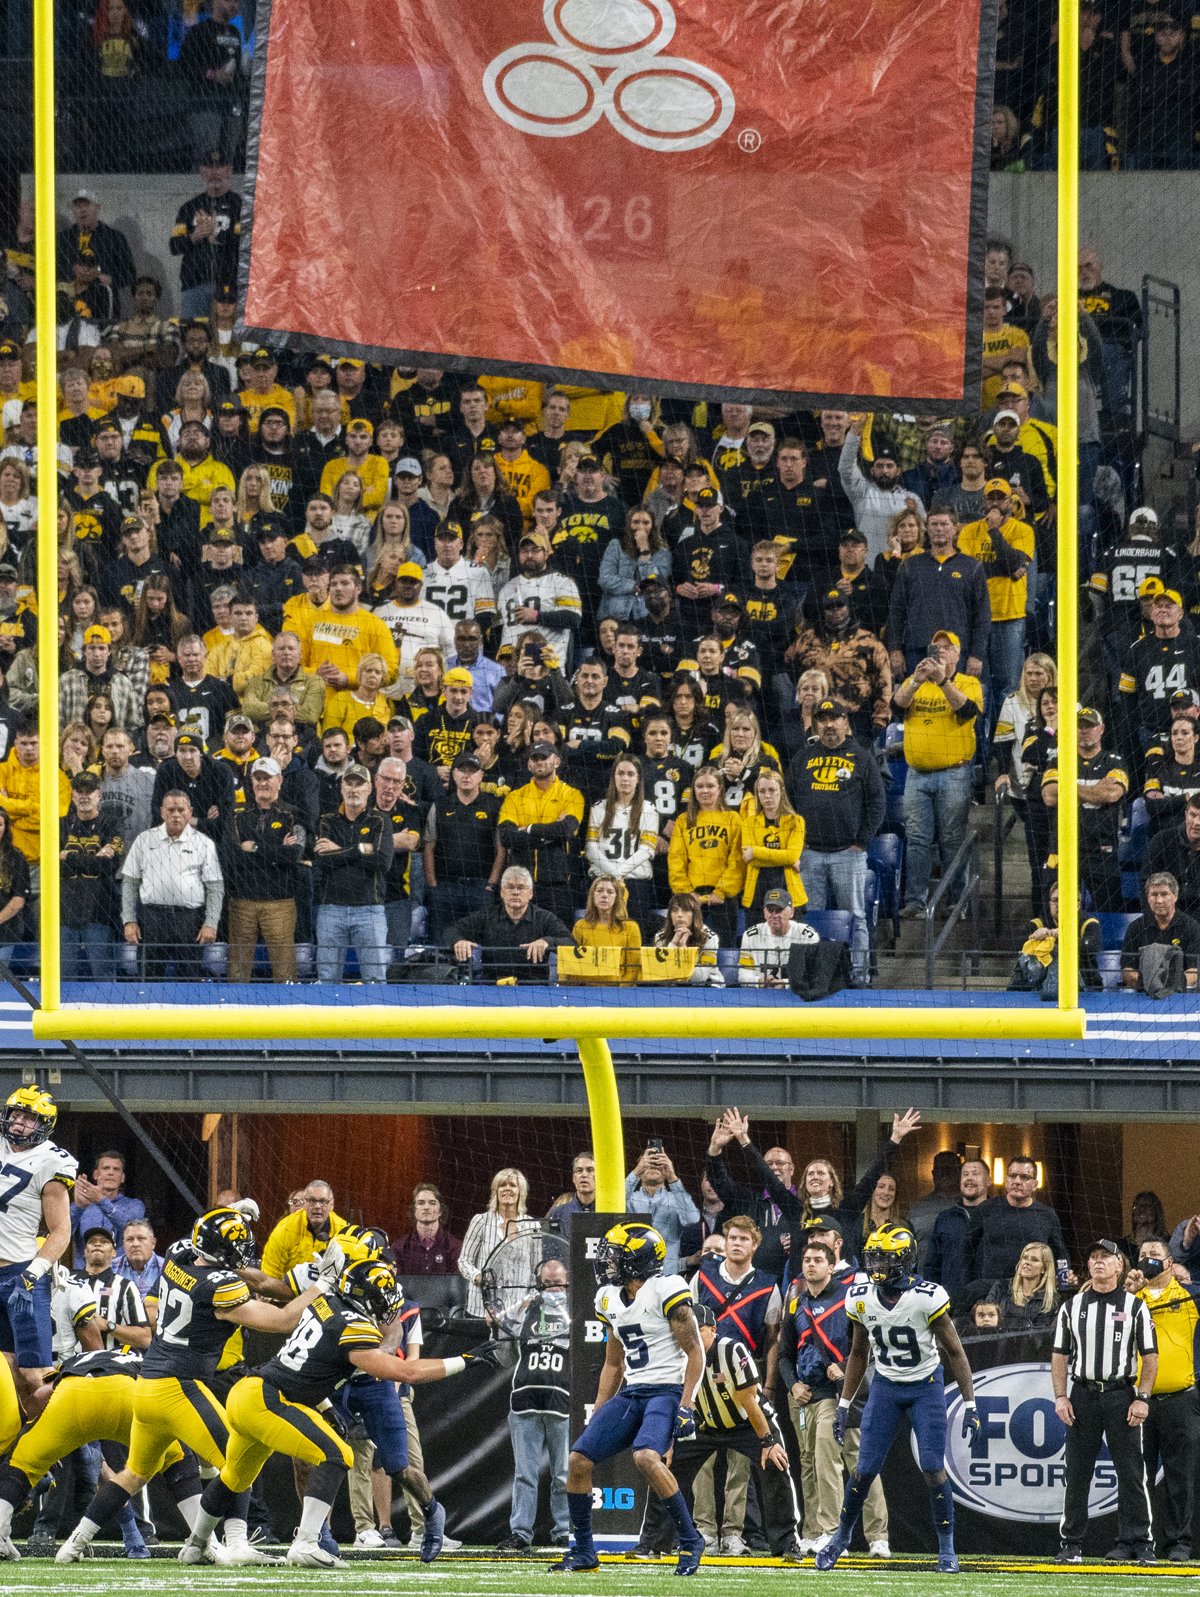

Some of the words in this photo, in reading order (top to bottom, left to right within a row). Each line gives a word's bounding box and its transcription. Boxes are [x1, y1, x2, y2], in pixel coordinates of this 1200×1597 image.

[561, 513, 609, 531] IOWA
[1114, 547, 1161, 559] LINDERBAUM
[1112, 565, 1161, 601] 65
[425, 585, 467, 620] 52
[1145, 664, 1187, 699] 44
[653, 780, 677, 815] 8
[811, 783, 841, 792] FOOTBALL
[603, 828, 641, 860] 30
[688, 825, 729, 846] IOWA
[100, 1307, 108, 1318] F
[156, 1275, 194, 1347] 92
[1080, 1311, 1087, 1319] S
[278, 1306, 323, 1372] 38
[617, 1323, 650, 1370] 5
[872, 1325, 921, 1367] 19
[1114, 1331, 1121, 1342] B
[528, 1352, 563, 1372] 030
[721, 1391, 730, 1401] S
[969, 1463, 1118, 1488] SPORS
